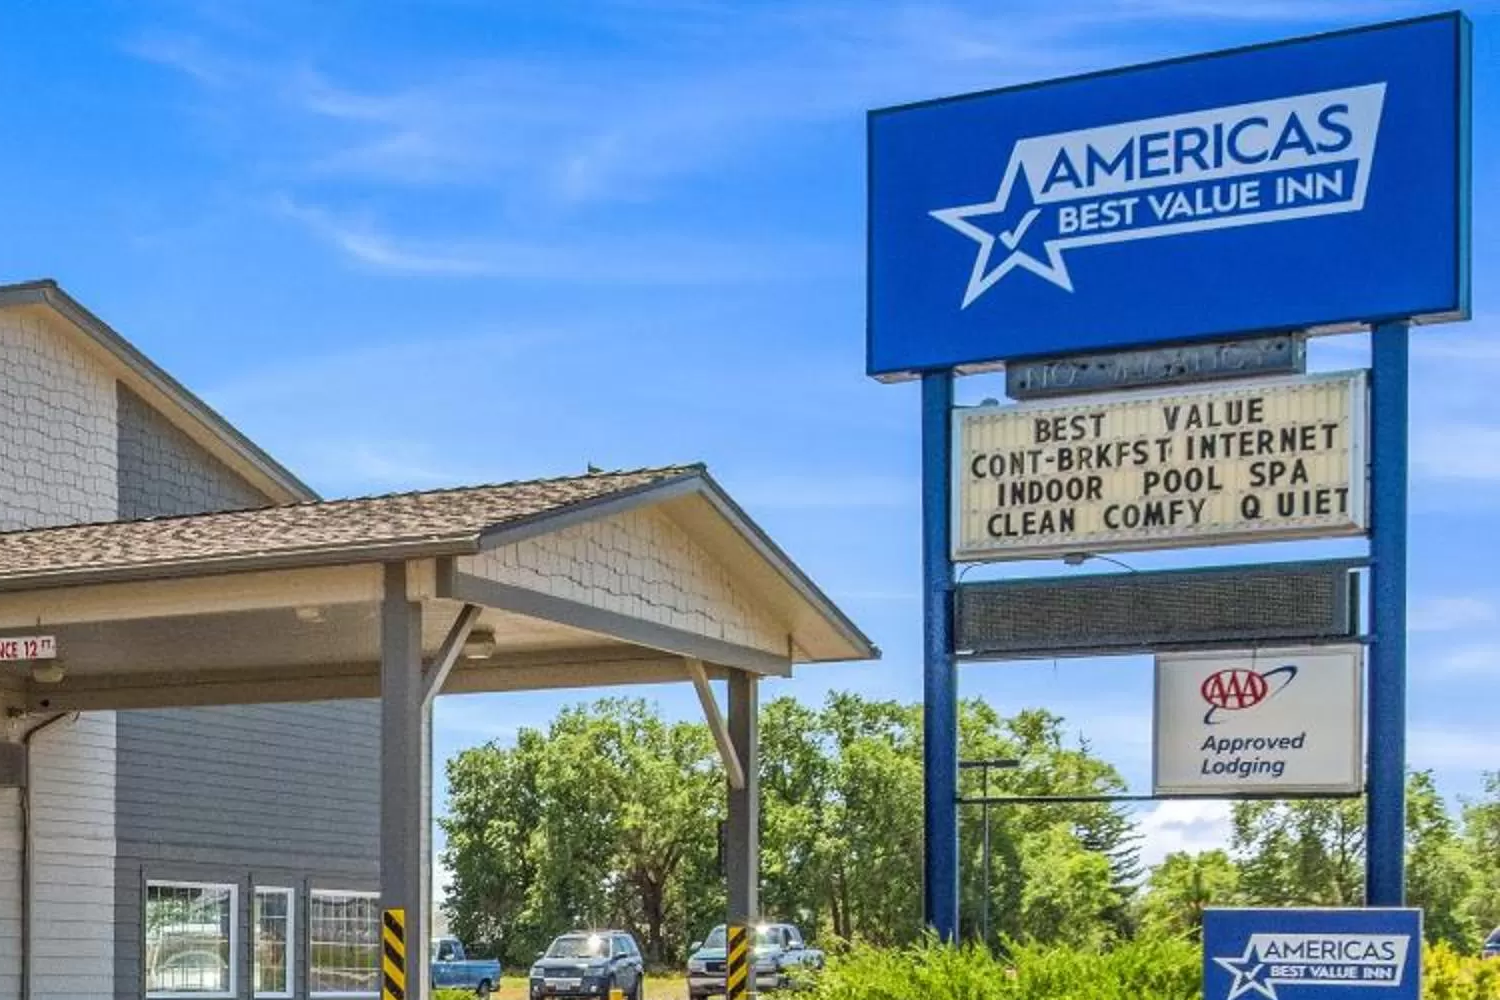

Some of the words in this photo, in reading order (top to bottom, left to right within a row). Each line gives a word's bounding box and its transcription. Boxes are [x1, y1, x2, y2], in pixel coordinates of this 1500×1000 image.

[1041, 104, 1352, 194] AMERICAS
[1059, 198, 1140, 234] BEST
[1148, 181, 1261, 221] VALUE
[1275, 169, 1343, 205] INN
[1034, 413, 1106, 443] BEST
[1163, 398, 1264, 431] VALUE
[971, 438, 1172, 479] CONT-BRKFST
[1186, 423, 1338, 461] INTERNET
[999, 476, 1103, 507] INDOOR
[1143, 465, 1223, 496] POOL
[1249, 459, 1308, 488] SPA
[987, 508, 1075, 537] CLEAN
[1103, 497, 1207, 530] COMFY
[23, 640, 38, 658] 12
[1207, 670, 1263, 708] AAA
[1200, 731, 1306, 755] Approved
[1201, 757, 1285, 779] Lodging
[1263, 940, 1396, 961] AMERICAS
[1270, 965, 1306, 978] BEST
[1309, 965, 1360, 979] VALUE
[1363, 967, 1393, 980] INN
